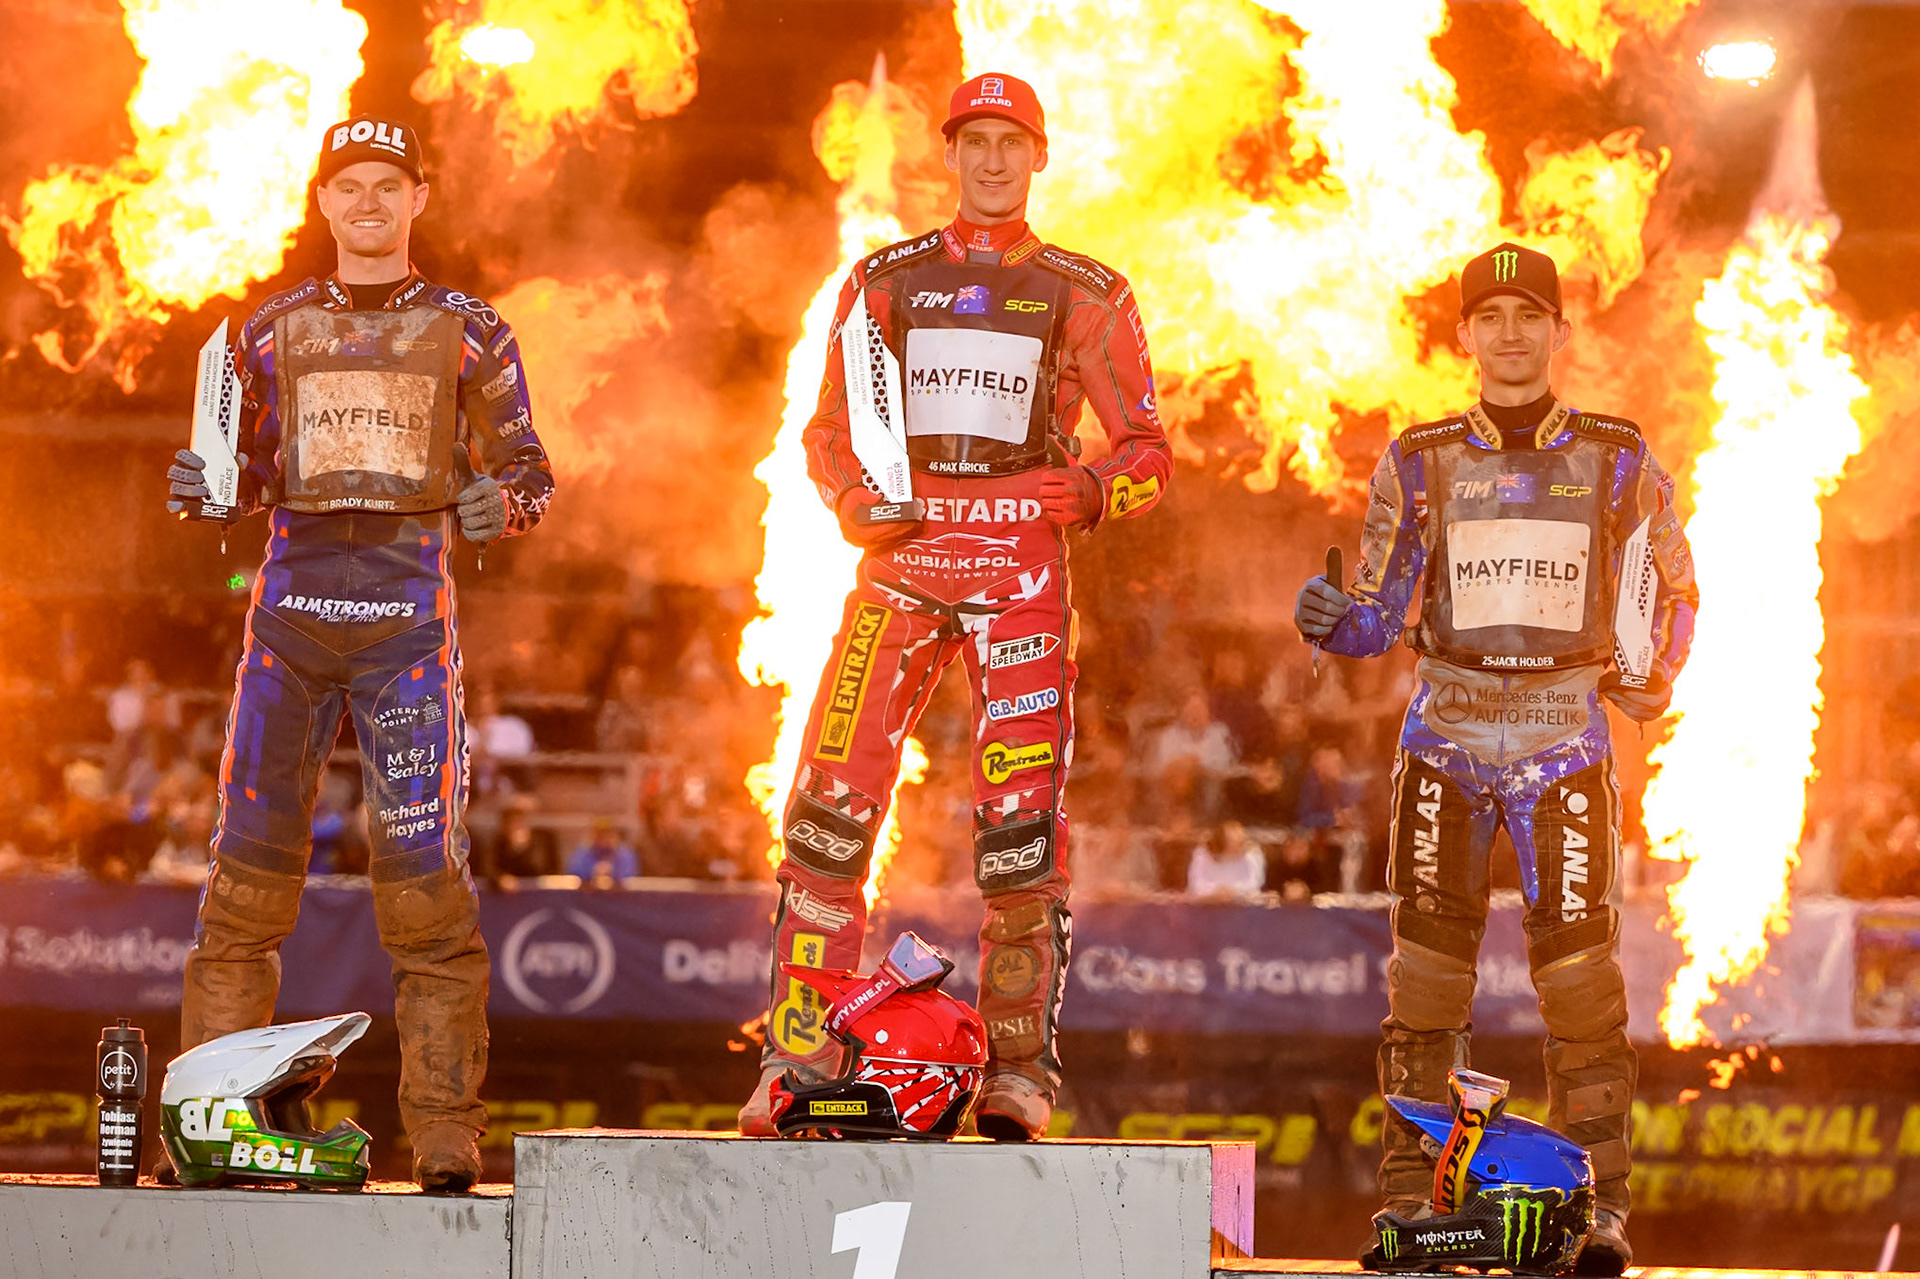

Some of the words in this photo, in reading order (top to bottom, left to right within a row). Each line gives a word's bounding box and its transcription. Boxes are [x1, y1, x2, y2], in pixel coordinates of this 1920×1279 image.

[970, 97, 1012, 107] BETARD
[331, 121, 406, 152] BOLL
[886, 234, 938, 263] ANLAS
[910, 291, 955, 309] FIM
[1004, 299, 1049, 314] SGP
[911, 368, 1028, 394] MAYFIELD
[971, 390, 1025, 404] EVENTS
[303, 408, 423, 432] MAYFIELD
[1411, 422, 1464, 440] MONSTER
[1597, 421, 1642, 442] MONSTE
[928, 461, 939, 471] 46
[939, 462, 956, 474] MAX
[959, 462, 990, 473] FRICKE
[225, 467, 234, 490] PLACE
[894, 461, 905, 497] WINNER
[223, 491, 232, 504] 2ND
[1452, 481, 1493, 499] FIM
[1549, 484, 1592, 498] SGP
[201, 505, 228, 515] SGP
[330, 498, 363, 509] BRADY
[365, 499, 396, 511] KURTZ
[870, 504, 901, 516] SGP
[893, 552, 1020, 570] KUBIAKPOL
[906, 569, 936, 578] AUTO
[943, 571, 998, 580] SERWIS
[1456, 559, 1579, 582] MAYFIELD
[1457, 578, 1512, 590] SPORTS
[1524, 578, 1578, 591] EVENTS
[277, 594, 416, 617] ARMSTRONG'S
[835, 610, 881, 710] ENTRACK
[992, 648, 1043, 668] SPEEDWAY
[1519, 656, 1555, 667] HOLDER
[1620, 674, 1647, 685] SGP
[989, 700, 1015, 718] G.B.
[1017, 690, 1057, 713] AUTO
[1475, 689, 1578, 705] Mercedes-Benz
[374, 707, 419, 725] EASTERN
[381, 716, 415, 729] POINT
[1475, 709, 1520, 725] AUTO
[1525, 709, 1580, 725] FRELIK
[387, 751, 404, 768] M
[408, 747, 425, 763] &
[427, 743, 436, 763] J
[387, 761, 438, 782] Sealey
[379, 798, 439, 824] Richard
[386, 817, 436, 840] Hayes
[1413, 778, 1443, 887] ANLAS
[786, 819, 863, 861] pod
[979, 837, 1046, 881] pod
[1561, 825, 1589, 923] ANLAS
[105, 1063, 132, 1079] petit
[101, 1111, 136, 1123] Tobiasz
[826, 1103, 863, 1113] ENTRACK
[100, 1123, 136, 1136] Herman
[1700, 1102, 1883, 1156] SOCIAL
[229, 1141, 317, 1174] BOLL
[831, 1201, 912, 1279] 1
[1415, 1228, 1486, 1246] MONSTER
[1426, 1243, 1475, 1253] ENERGY
